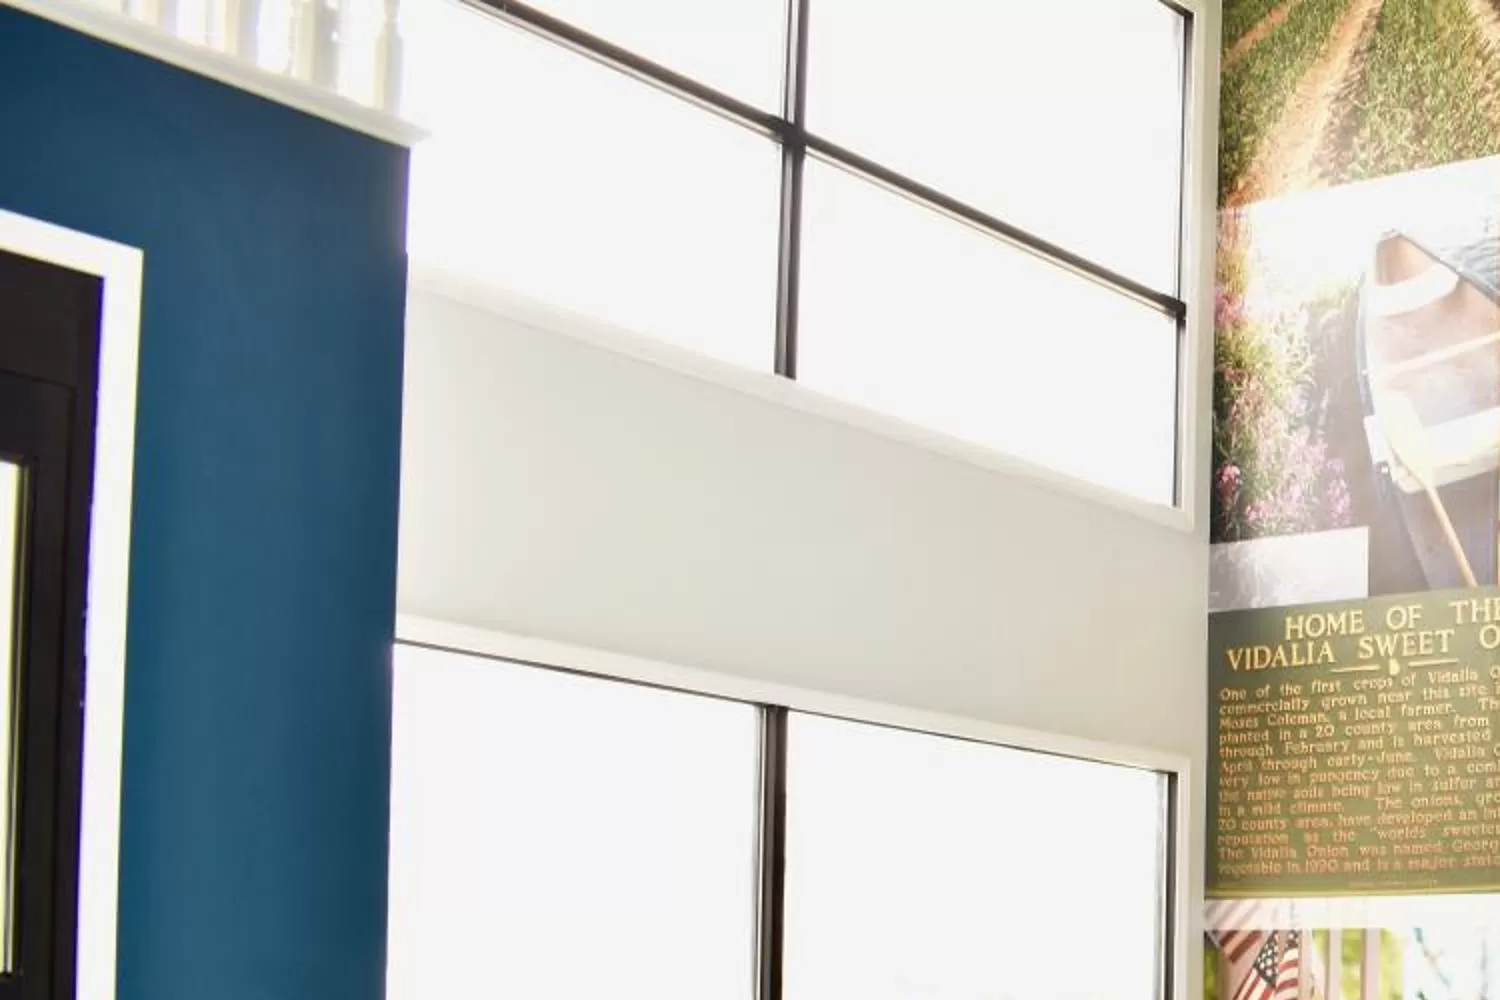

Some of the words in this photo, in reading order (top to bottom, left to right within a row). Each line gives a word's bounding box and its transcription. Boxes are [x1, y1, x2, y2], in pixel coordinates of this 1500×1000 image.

[1285, 609, 1365, 641] HOME
[1386, 604, 1423, 631] OF
[1227, 640, 1337, 672] VIDALIA
[1358, 628, 1455, 660] SWEET
[1220, 687, 1247, 700] One
[1255, 684, 1270, 698] of
[1280, 683, 1303, 696] the
[1311, 680, 1343, 694] first
[1353, 677, 1393, 691] crops
[1401, 671, 1416, 687] of
[1428, 666, 1479, 685] Vidalia
[1219, 698, 1310, 715] commercially
[1322, 695, 1367, 711] grown
[1377, 691, 1412, 704] near
[1423, 687, 1449, 701] this
[1459, 683, 1488, 697] site
[1219, 717, 1259, 729] Moses
[1338, 711, 1347, 721] a
[1355, 706, 1391, 721] local
[1401, 703, 1457, 716] farmer.
[1219, 730, 1269, 746] planted
[1280, 729, 1291, 741] in
[1299, 730, 1308, 739] a
[1316, 724, 1335, 737] 20
[1346, 722, 1394, 737] county
[1408, 719, 1441, 731] area
[1454, 714, 1489, 728] from
[1218, 743, 1274, 760] through
[1284, 740, 1349, 756] February
[1358, 736, 1384, 749] and
[1393, 735, 1405, 748] is
[1413, 728, 1491, 746] harvested
[1220, 760, 1253, 775] April
[1261, 756, 1317, 772] through
[1435, 743, 1485, 761] Vidalia
[1258, 772, 1280, 786] low
[1309, 769, 1378, 788] pungency
[1387, 766, 1415, 780] due
[1424, 764, 1440, 777] to
[1447, 765, 1456, 776] a
[1247, 788, 1285, 801] native
[1293, 787, 1324, 799] soils
[1331, 784, 1370, 799] being
[1377, 782, 1401, 795] low
[1409, 780, 1423, 793] in
[1376, 797, 1402, 811] The
[1218, 818, 1237, 831] 20
[1242, 817, 1287, 831] county
[1338, 814, 1371, 827] have
[1378, 810, 1453, 827] developed
[1459, 809, 1477, 821] an
[1217, 832, 1289, 846] reputation
[1333, 830, 1357, 843] the
[1218, 847, 1244, 860] The
[1251, 846, 1297, 860] Vidalia
[1307, 844, 1349, 858] Onion
[1359, 844, 1387, 857] was
[1393, 840, 1442, 855] named
[1287, 861, 1300, 874] in
[1343, 858, 1370, 873] and
[1408, 857, 1454, 871] major
[1463, 854, 1500, 868] state
